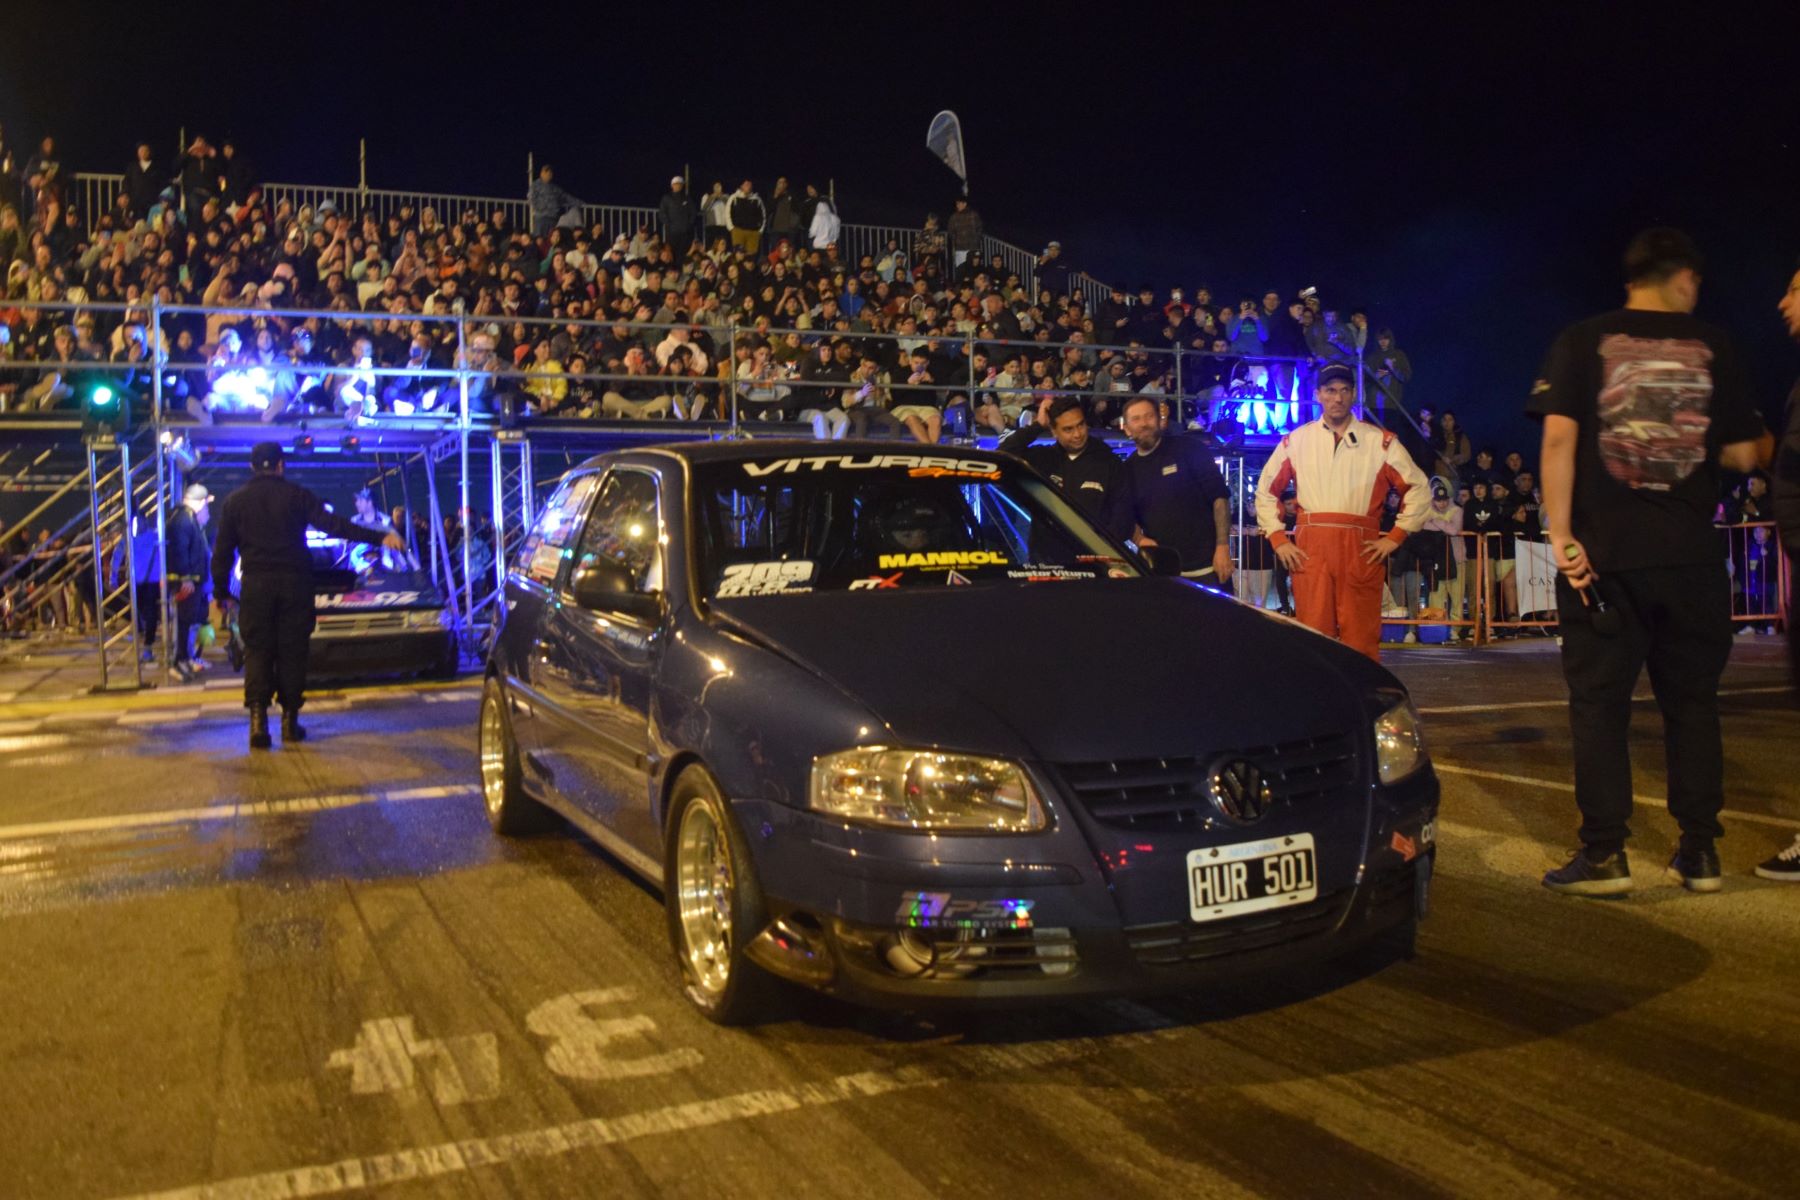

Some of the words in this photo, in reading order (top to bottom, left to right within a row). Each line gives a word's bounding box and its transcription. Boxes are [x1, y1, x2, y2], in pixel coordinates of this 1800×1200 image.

[743, 455, 998, 477] VITURRO
[879, 551, 1008, 569] MANNOL
[848, 572, 904, 591] FTX
[1194, 861, 1248, 908] HUR
[1263, 850, 1313, 896] 501
